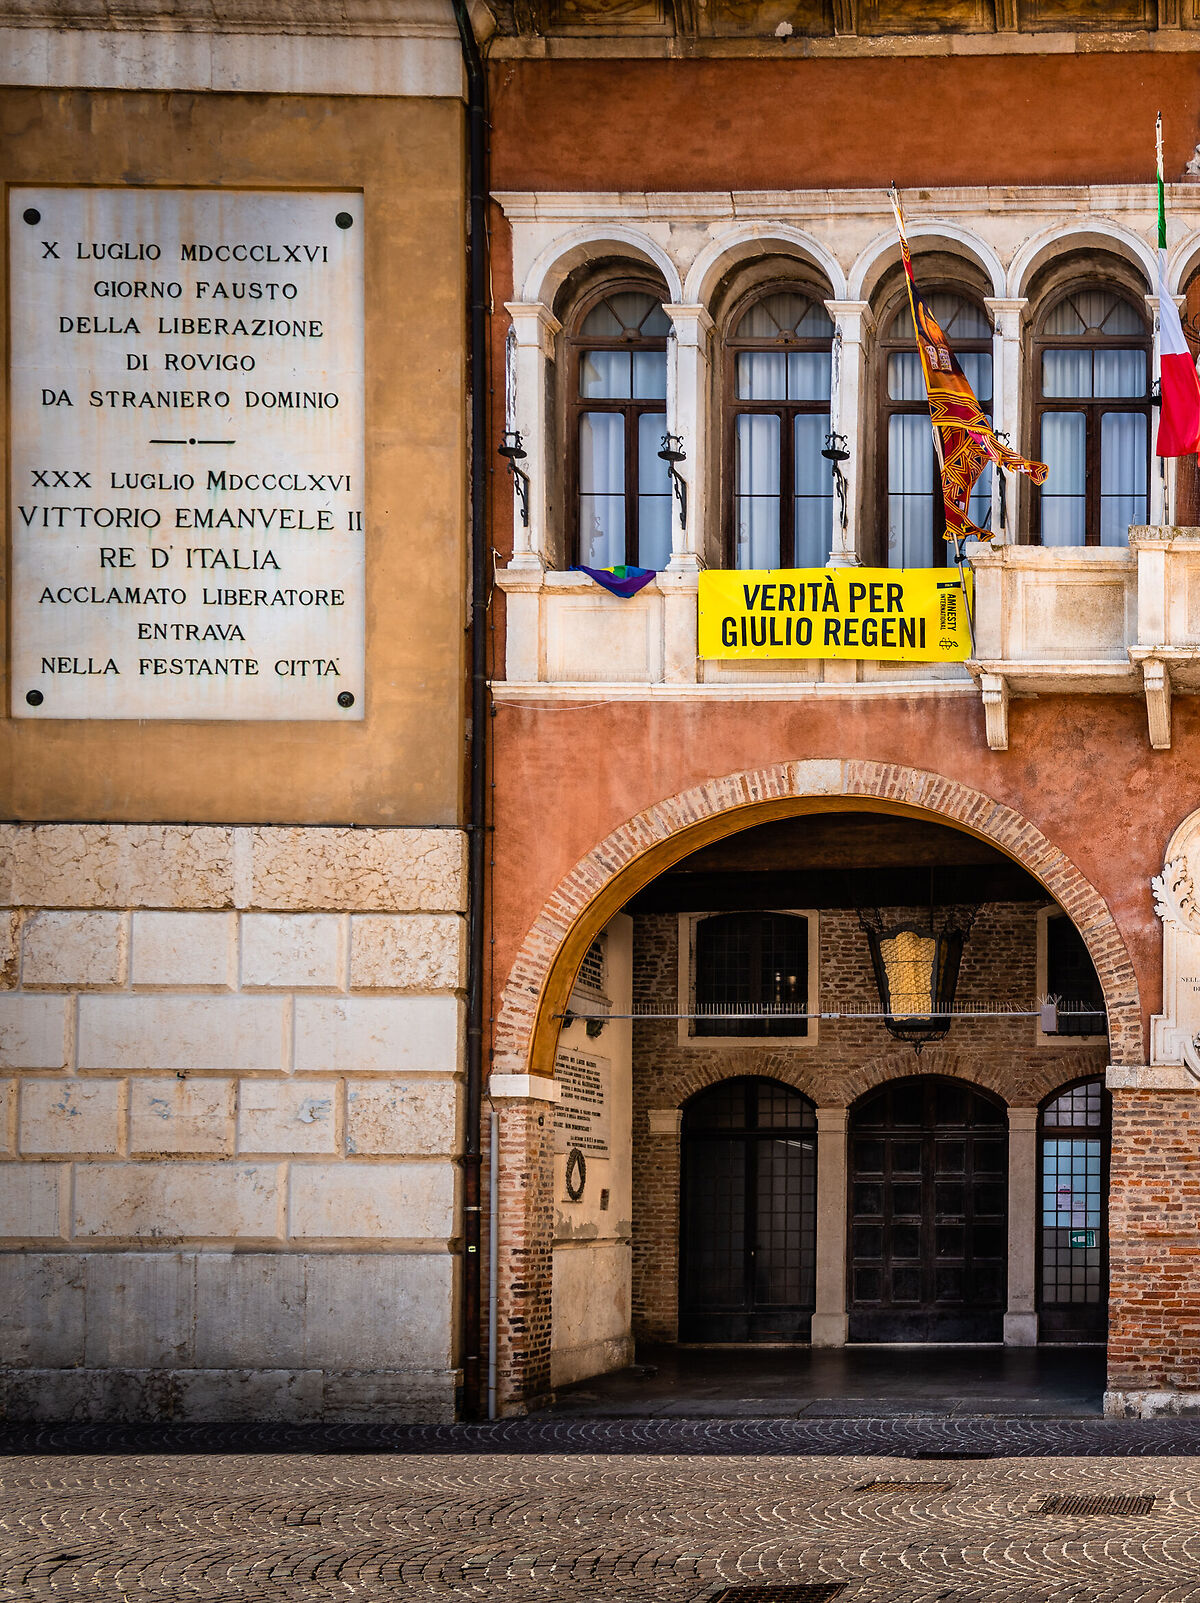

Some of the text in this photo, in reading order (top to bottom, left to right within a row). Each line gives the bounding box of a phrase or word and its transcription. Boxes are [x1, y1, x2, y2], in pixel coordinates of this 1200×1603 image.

[42, 242, 327, 262] X LUGLIO MDCCCLXVI
[94, 281, 297, 299] GIORNO FAUSTO
[60, 317, 323, 337] DELLA LIBERAZIONE
[127, 354, 255, 371] DI ROVIGO
[42, 389, 338, 408] DA STRANIERO DOMINIO
[31, 471, 350, 491] XXX LUGLIO MDCCCLXVI
[18, 506, 361, 530] VITTORIO EMANVELE II
[100, 548, 136, 567] RE
[187, 549, 280, 569] ITALIA
[39, 587, 344, 606] ACCLAMATO LIBERATORE
[744, 575, 903, 612] VERITÀ PER
[948, 593, 957, 632] AMNESTY
[138, 623, 245, 640] ENTRAVA
[722, 616, 925, 648] GIULIO REGENI
[42, 657, 120, 674] NELLA
[140, 659, 258, 675] FESTANTE
